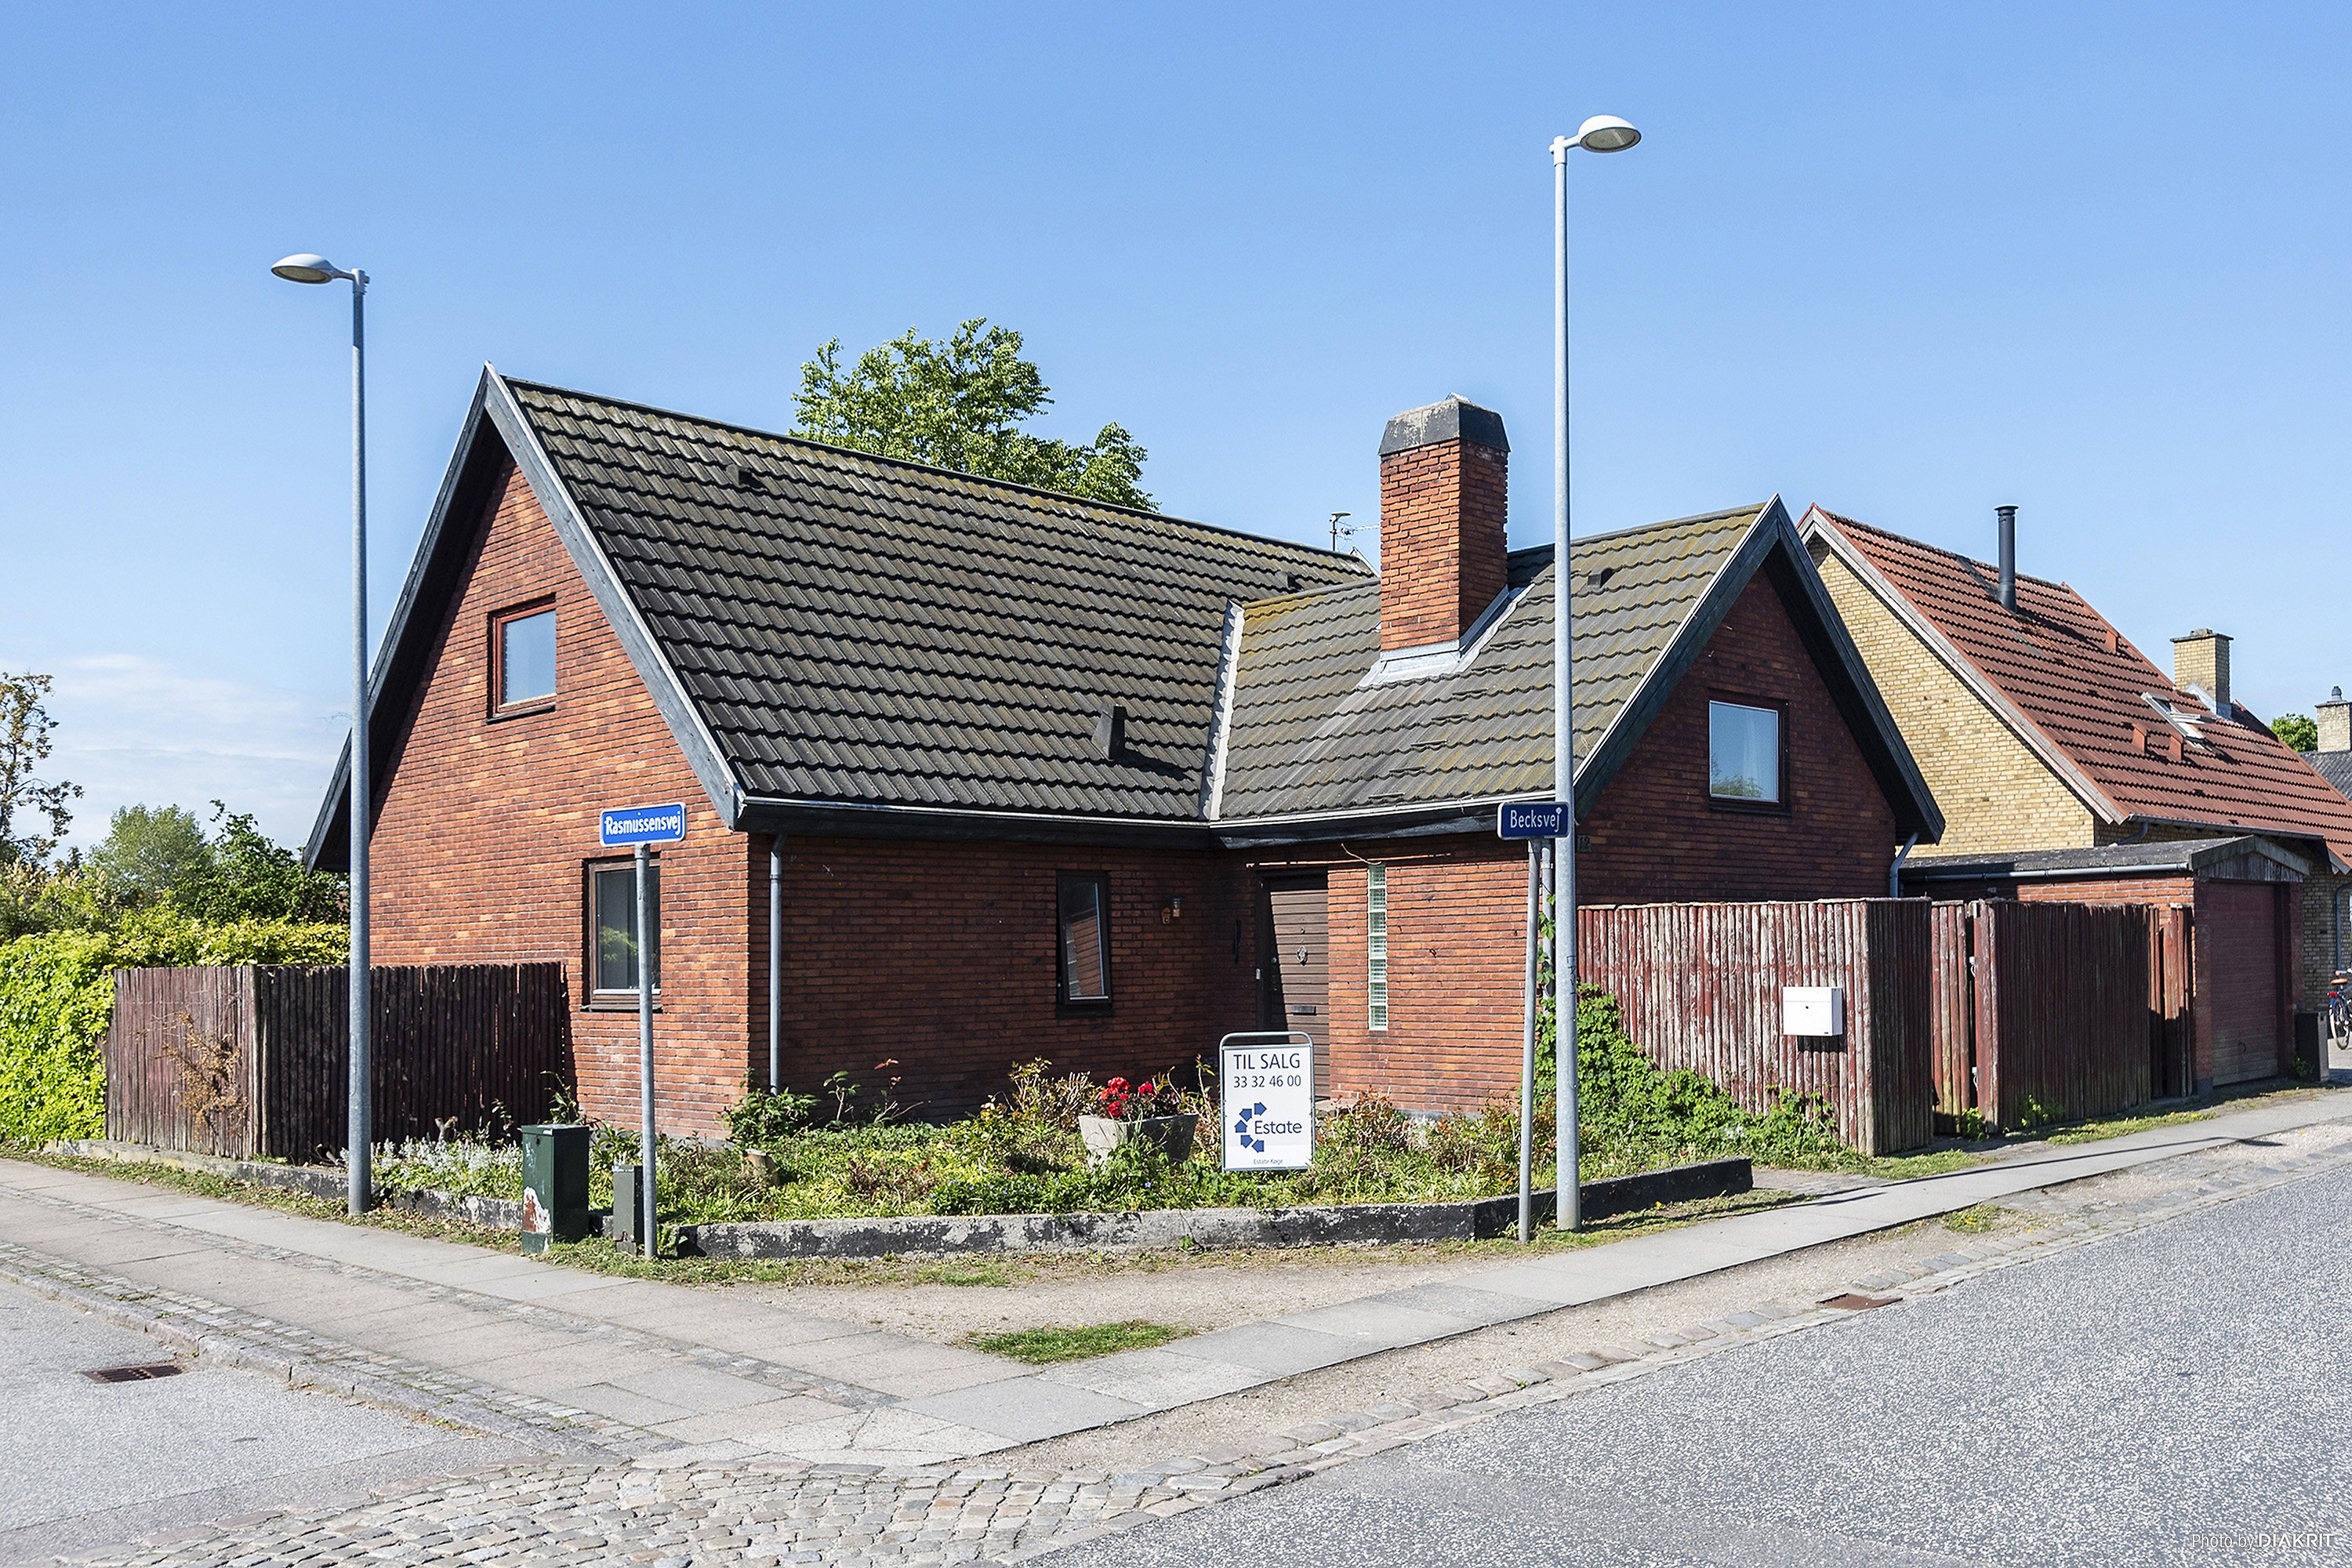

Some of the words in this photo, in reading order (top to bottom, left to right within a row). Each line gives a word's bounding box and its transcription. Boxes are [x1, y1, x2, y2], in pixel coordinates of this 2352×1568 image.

[604, 810, 681, 837] Rasmussensvej
[1510, 807, 1563, 833] Becksvej
[1233, 1054, 1255, 1069] TIL
[1260, 1053, 1301, 1069] SALG
[1233, 1076, 1247, 1088] 33
[1251, 1075, 1265, 1088] 32
[1269, 1075, 1283, 1087] 46
[1287, 1074, 1301, 1087] 00
[1254, 1120, 1302, 1134] Estate
